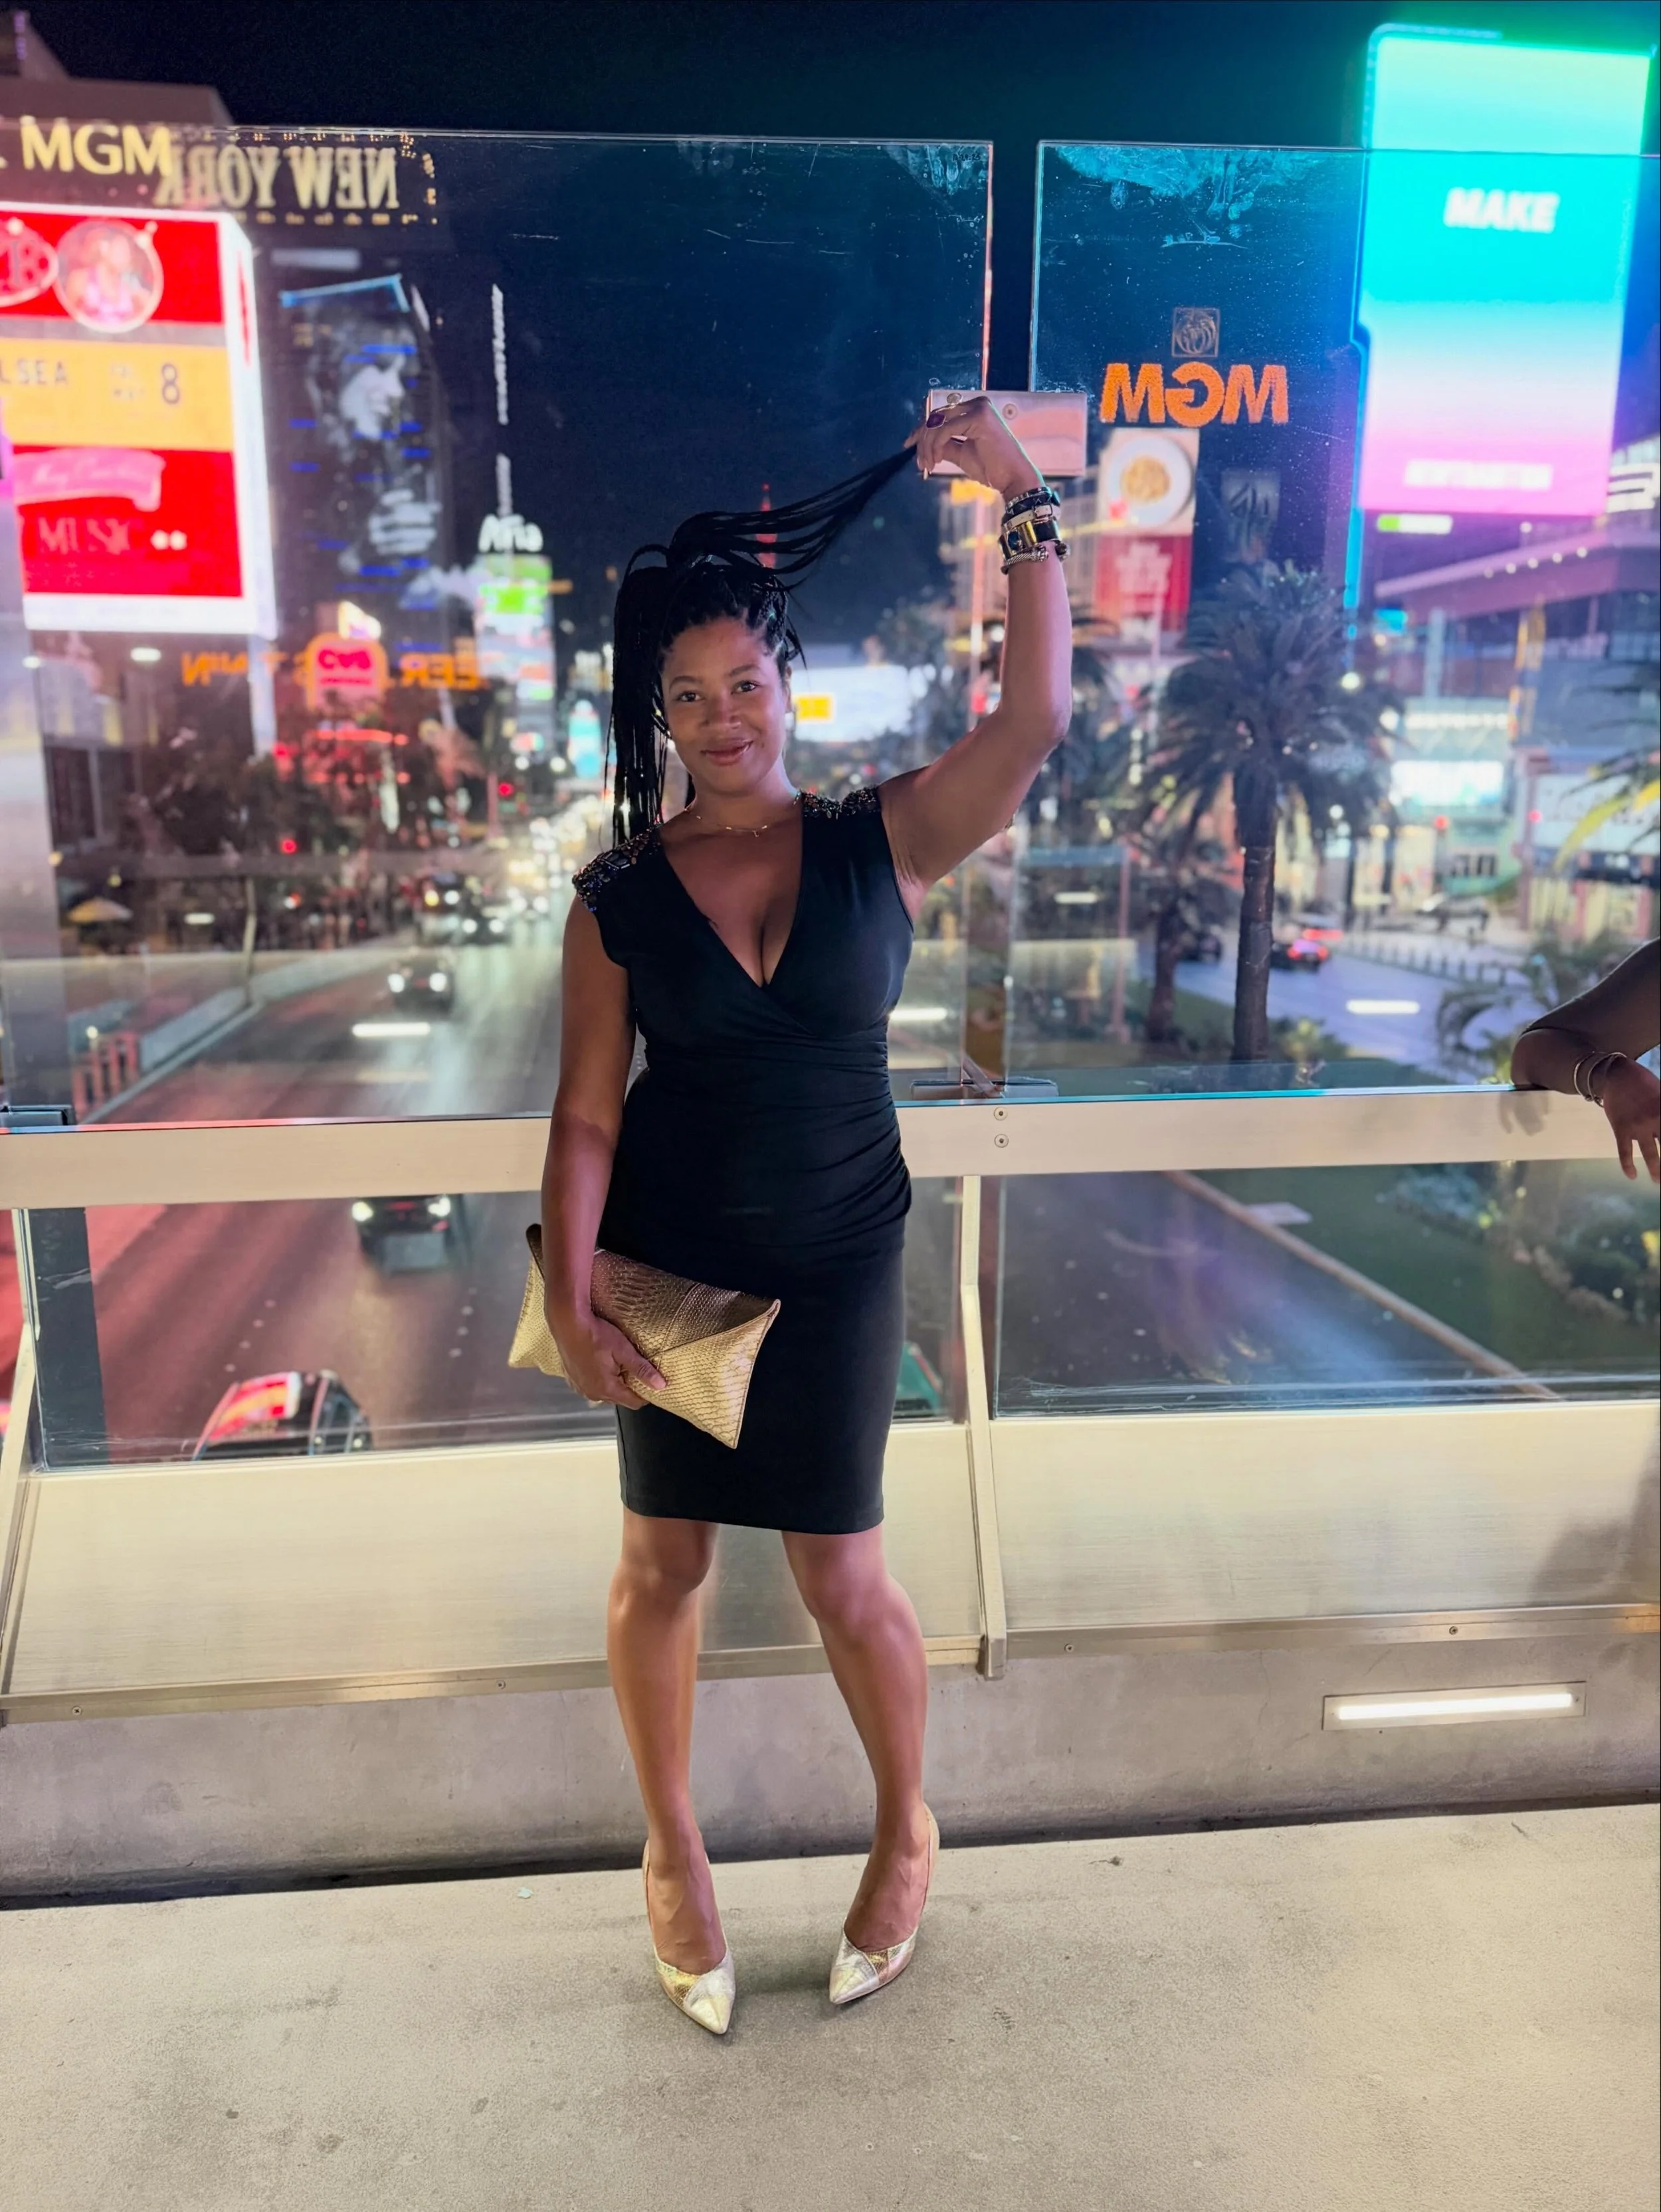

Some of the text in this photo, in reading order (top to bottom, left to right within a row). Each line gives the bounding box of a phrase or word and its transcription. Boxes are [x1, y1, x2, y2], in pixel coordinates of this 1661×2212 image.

[20, 116, 173, 176] MGM
[1443, 187, 1560, 233] MAKE
[161, 362, 180, 405] 8
